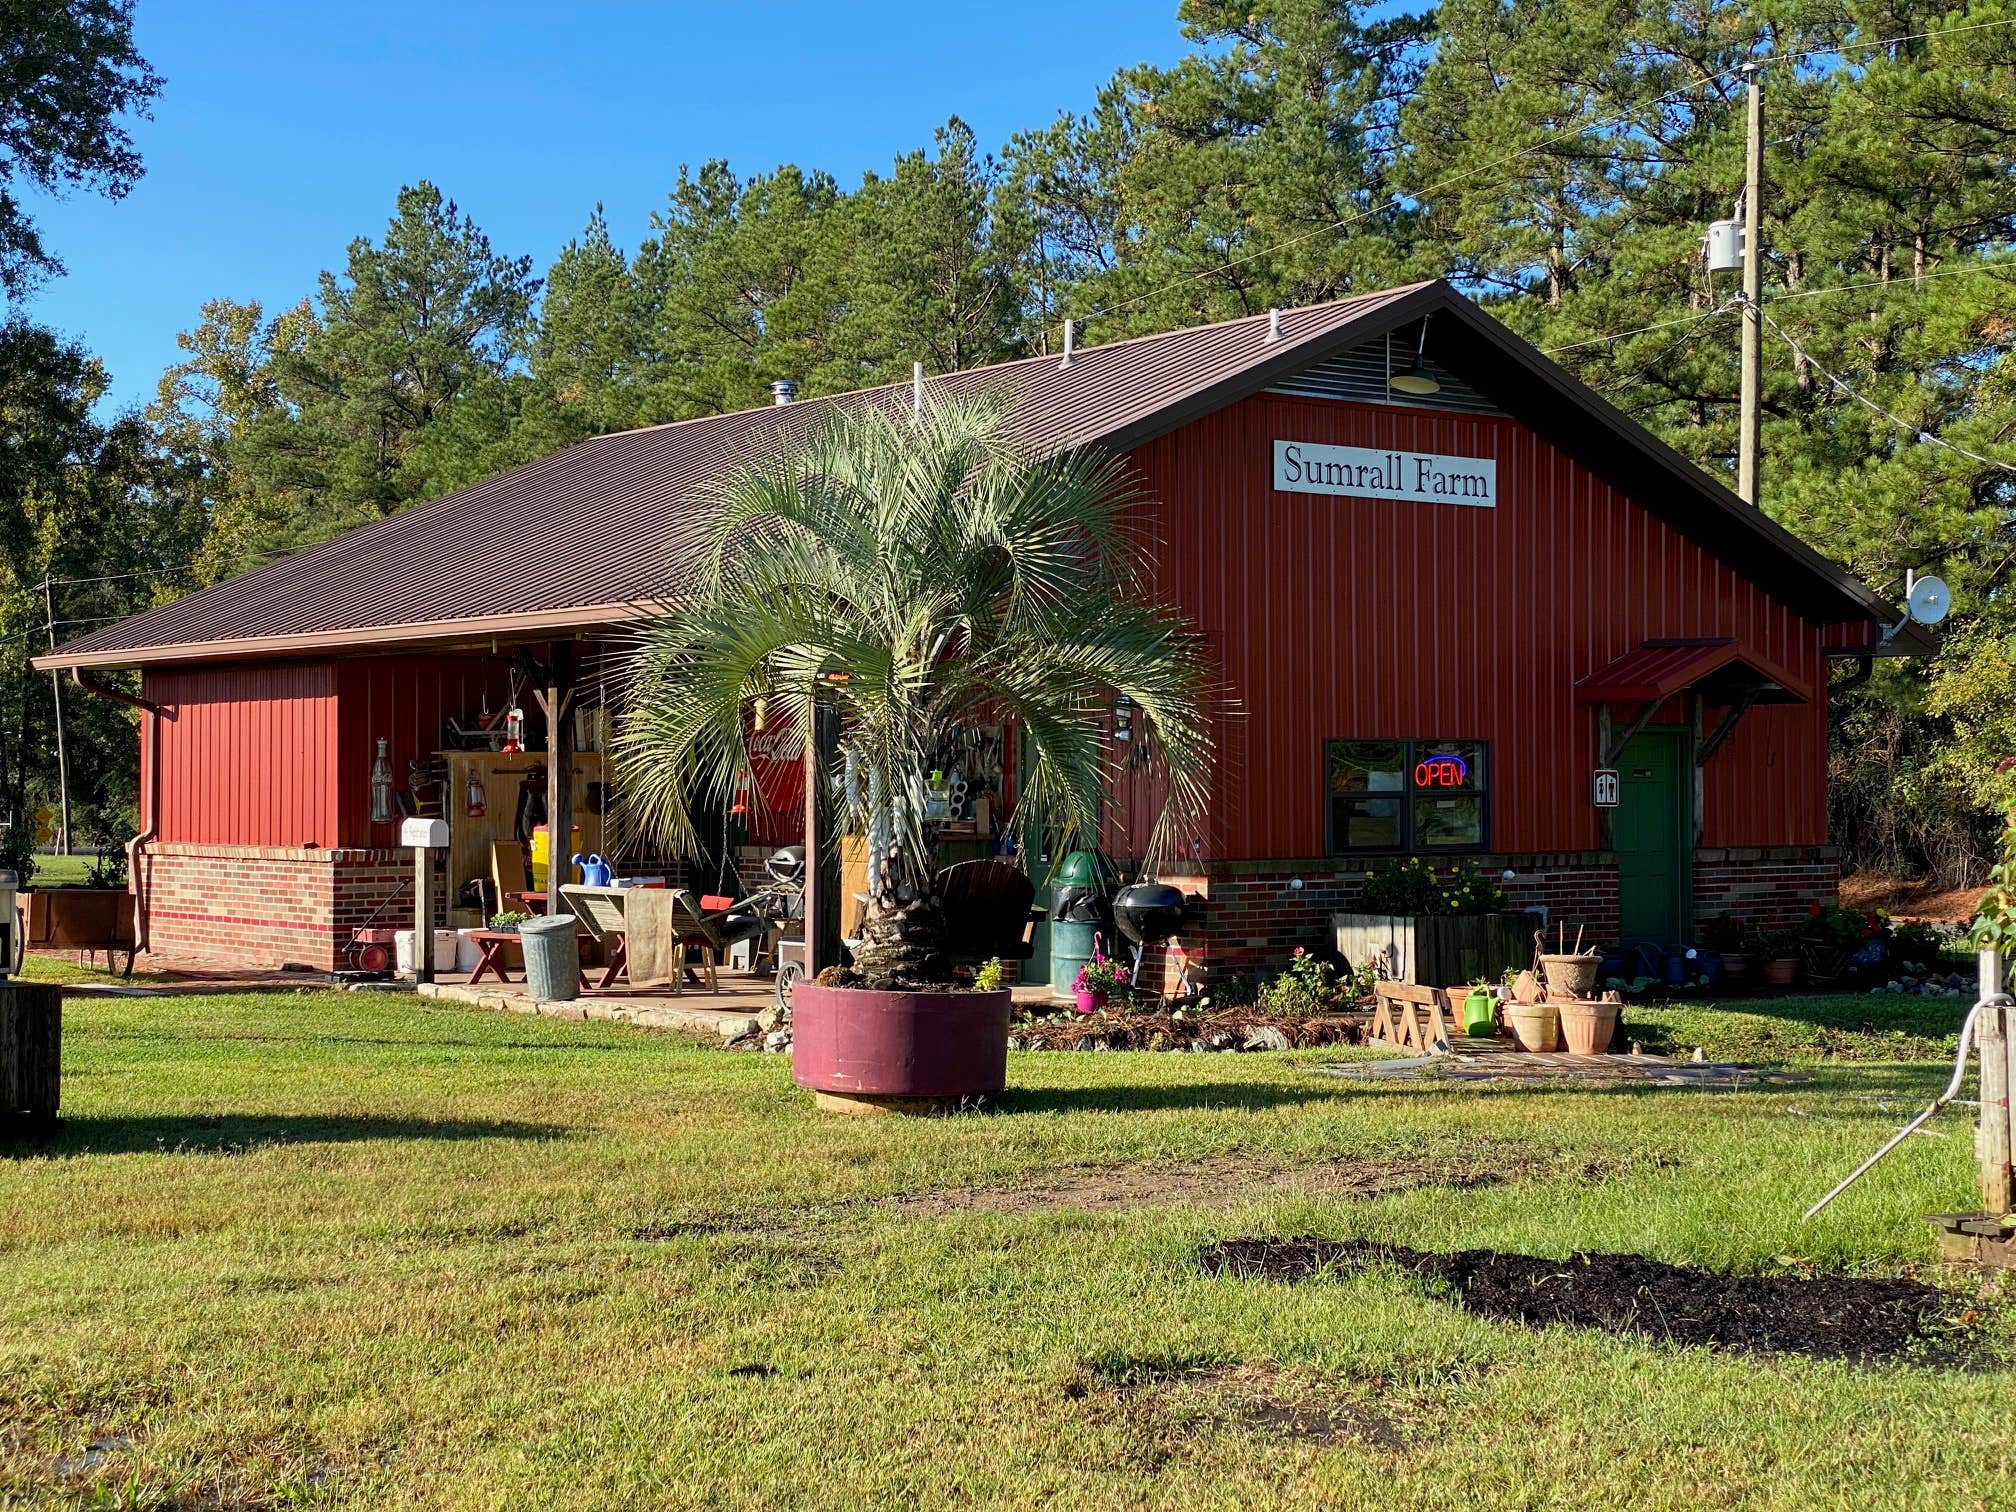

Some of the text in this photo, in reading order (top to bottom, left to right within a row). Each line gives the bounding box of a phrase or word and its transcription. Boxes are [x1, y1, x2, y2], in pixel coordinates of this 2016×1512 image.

[1284, 446, 1489, 497] Sumrall Farm
[1415, 763, 1463, 786] OPEN
